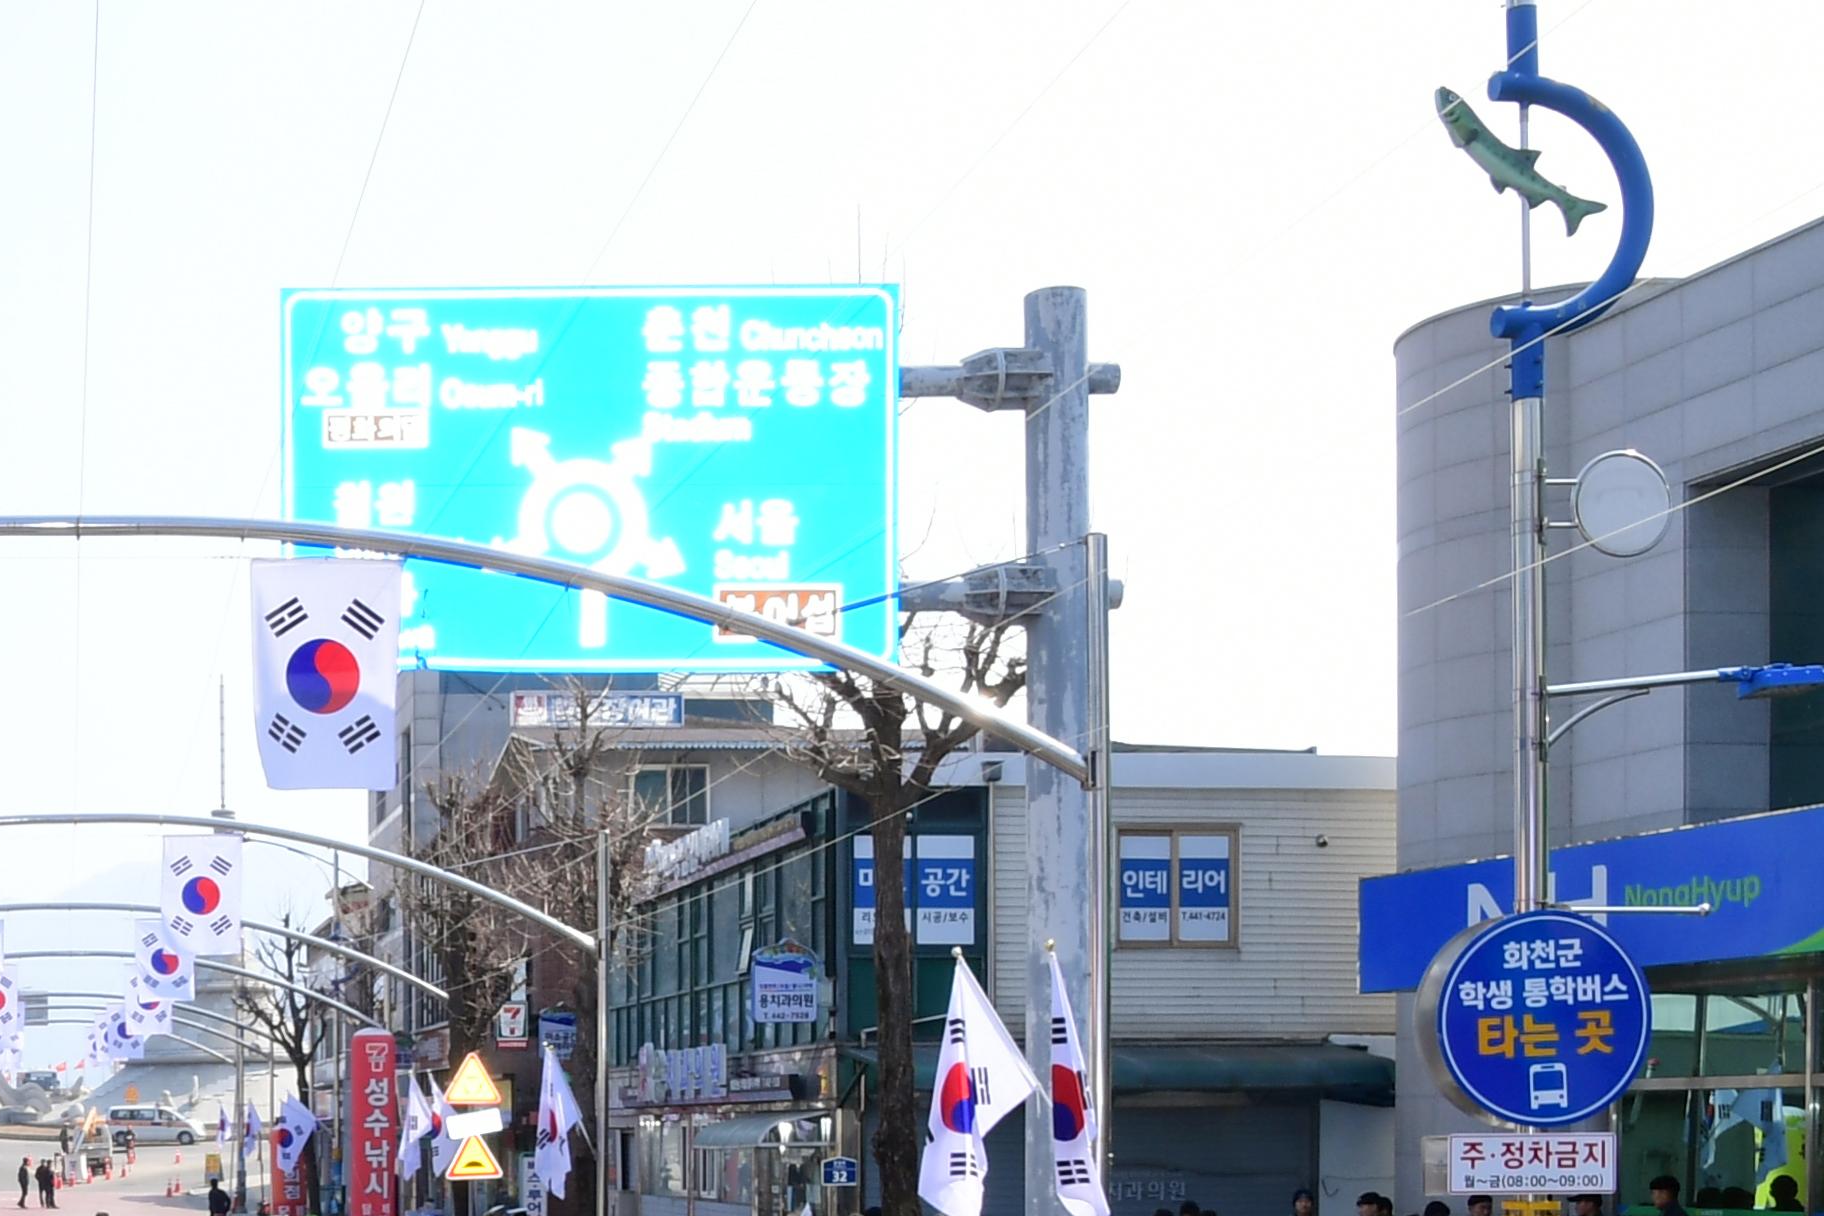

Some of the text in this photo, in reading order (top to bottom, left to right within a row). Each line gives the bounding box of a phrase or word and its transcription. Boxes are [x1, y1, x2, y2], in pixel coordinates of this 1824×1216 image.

[920, 867, 971, 897] 공간
[1502, 938, 1584, 970] 화천군
[1459, 973, 1630, 1011] 학생 통학버스
[1477, 1010, 1615, 1059] 타는 곳
[363, 1076, 390, 1199] 성수낚시
[832, 1170, 848, 1183] 32
